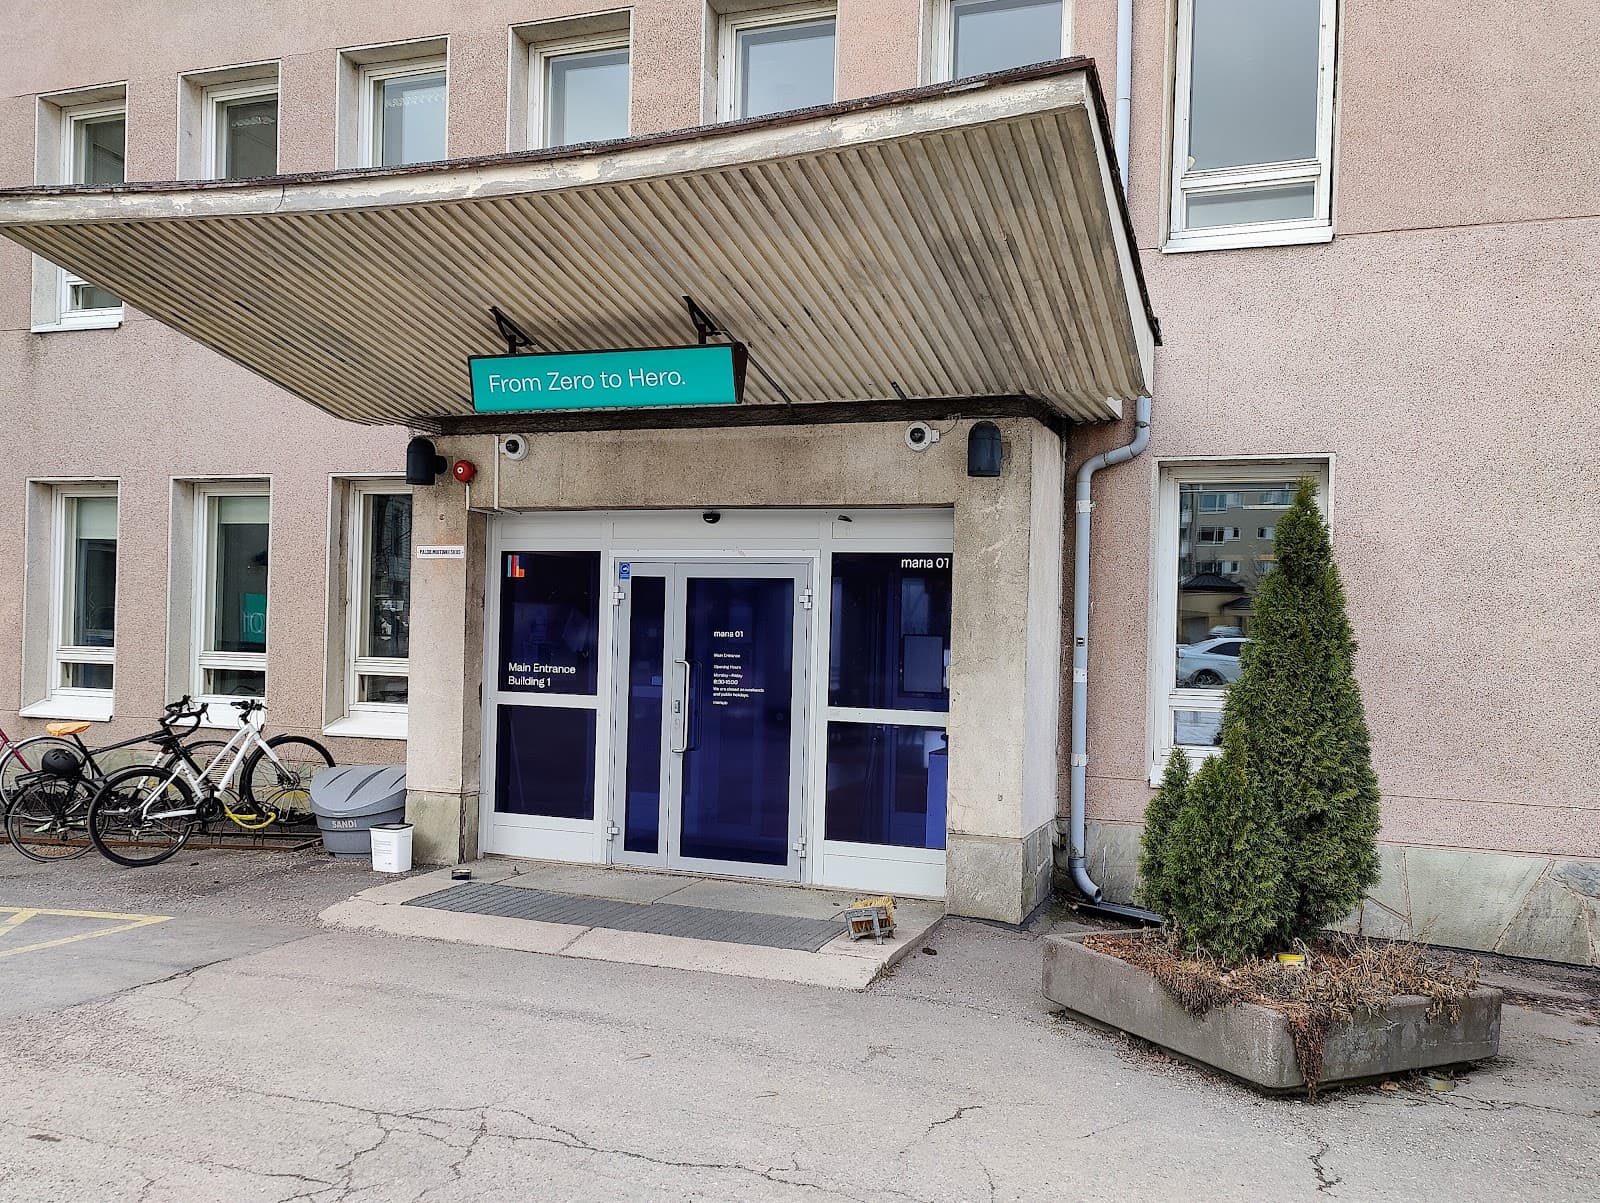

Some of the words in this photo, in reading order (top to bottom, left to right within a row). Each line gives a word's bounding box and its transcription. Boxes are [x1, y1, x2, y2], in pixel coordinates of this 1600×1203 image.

[488, 374, 542, 393] From
[546, 371, 595, 391] Zero
[599, 371, 622, 388] to
[628, 368, 686, 387] Hero.
[935, 557, 950, 569] 01
[508, 662, 531, 672] Main
[533, 663, 576, 674] Entrance
[508, 675, 546, 689] Building
[547, 677, 551, 687] 1
